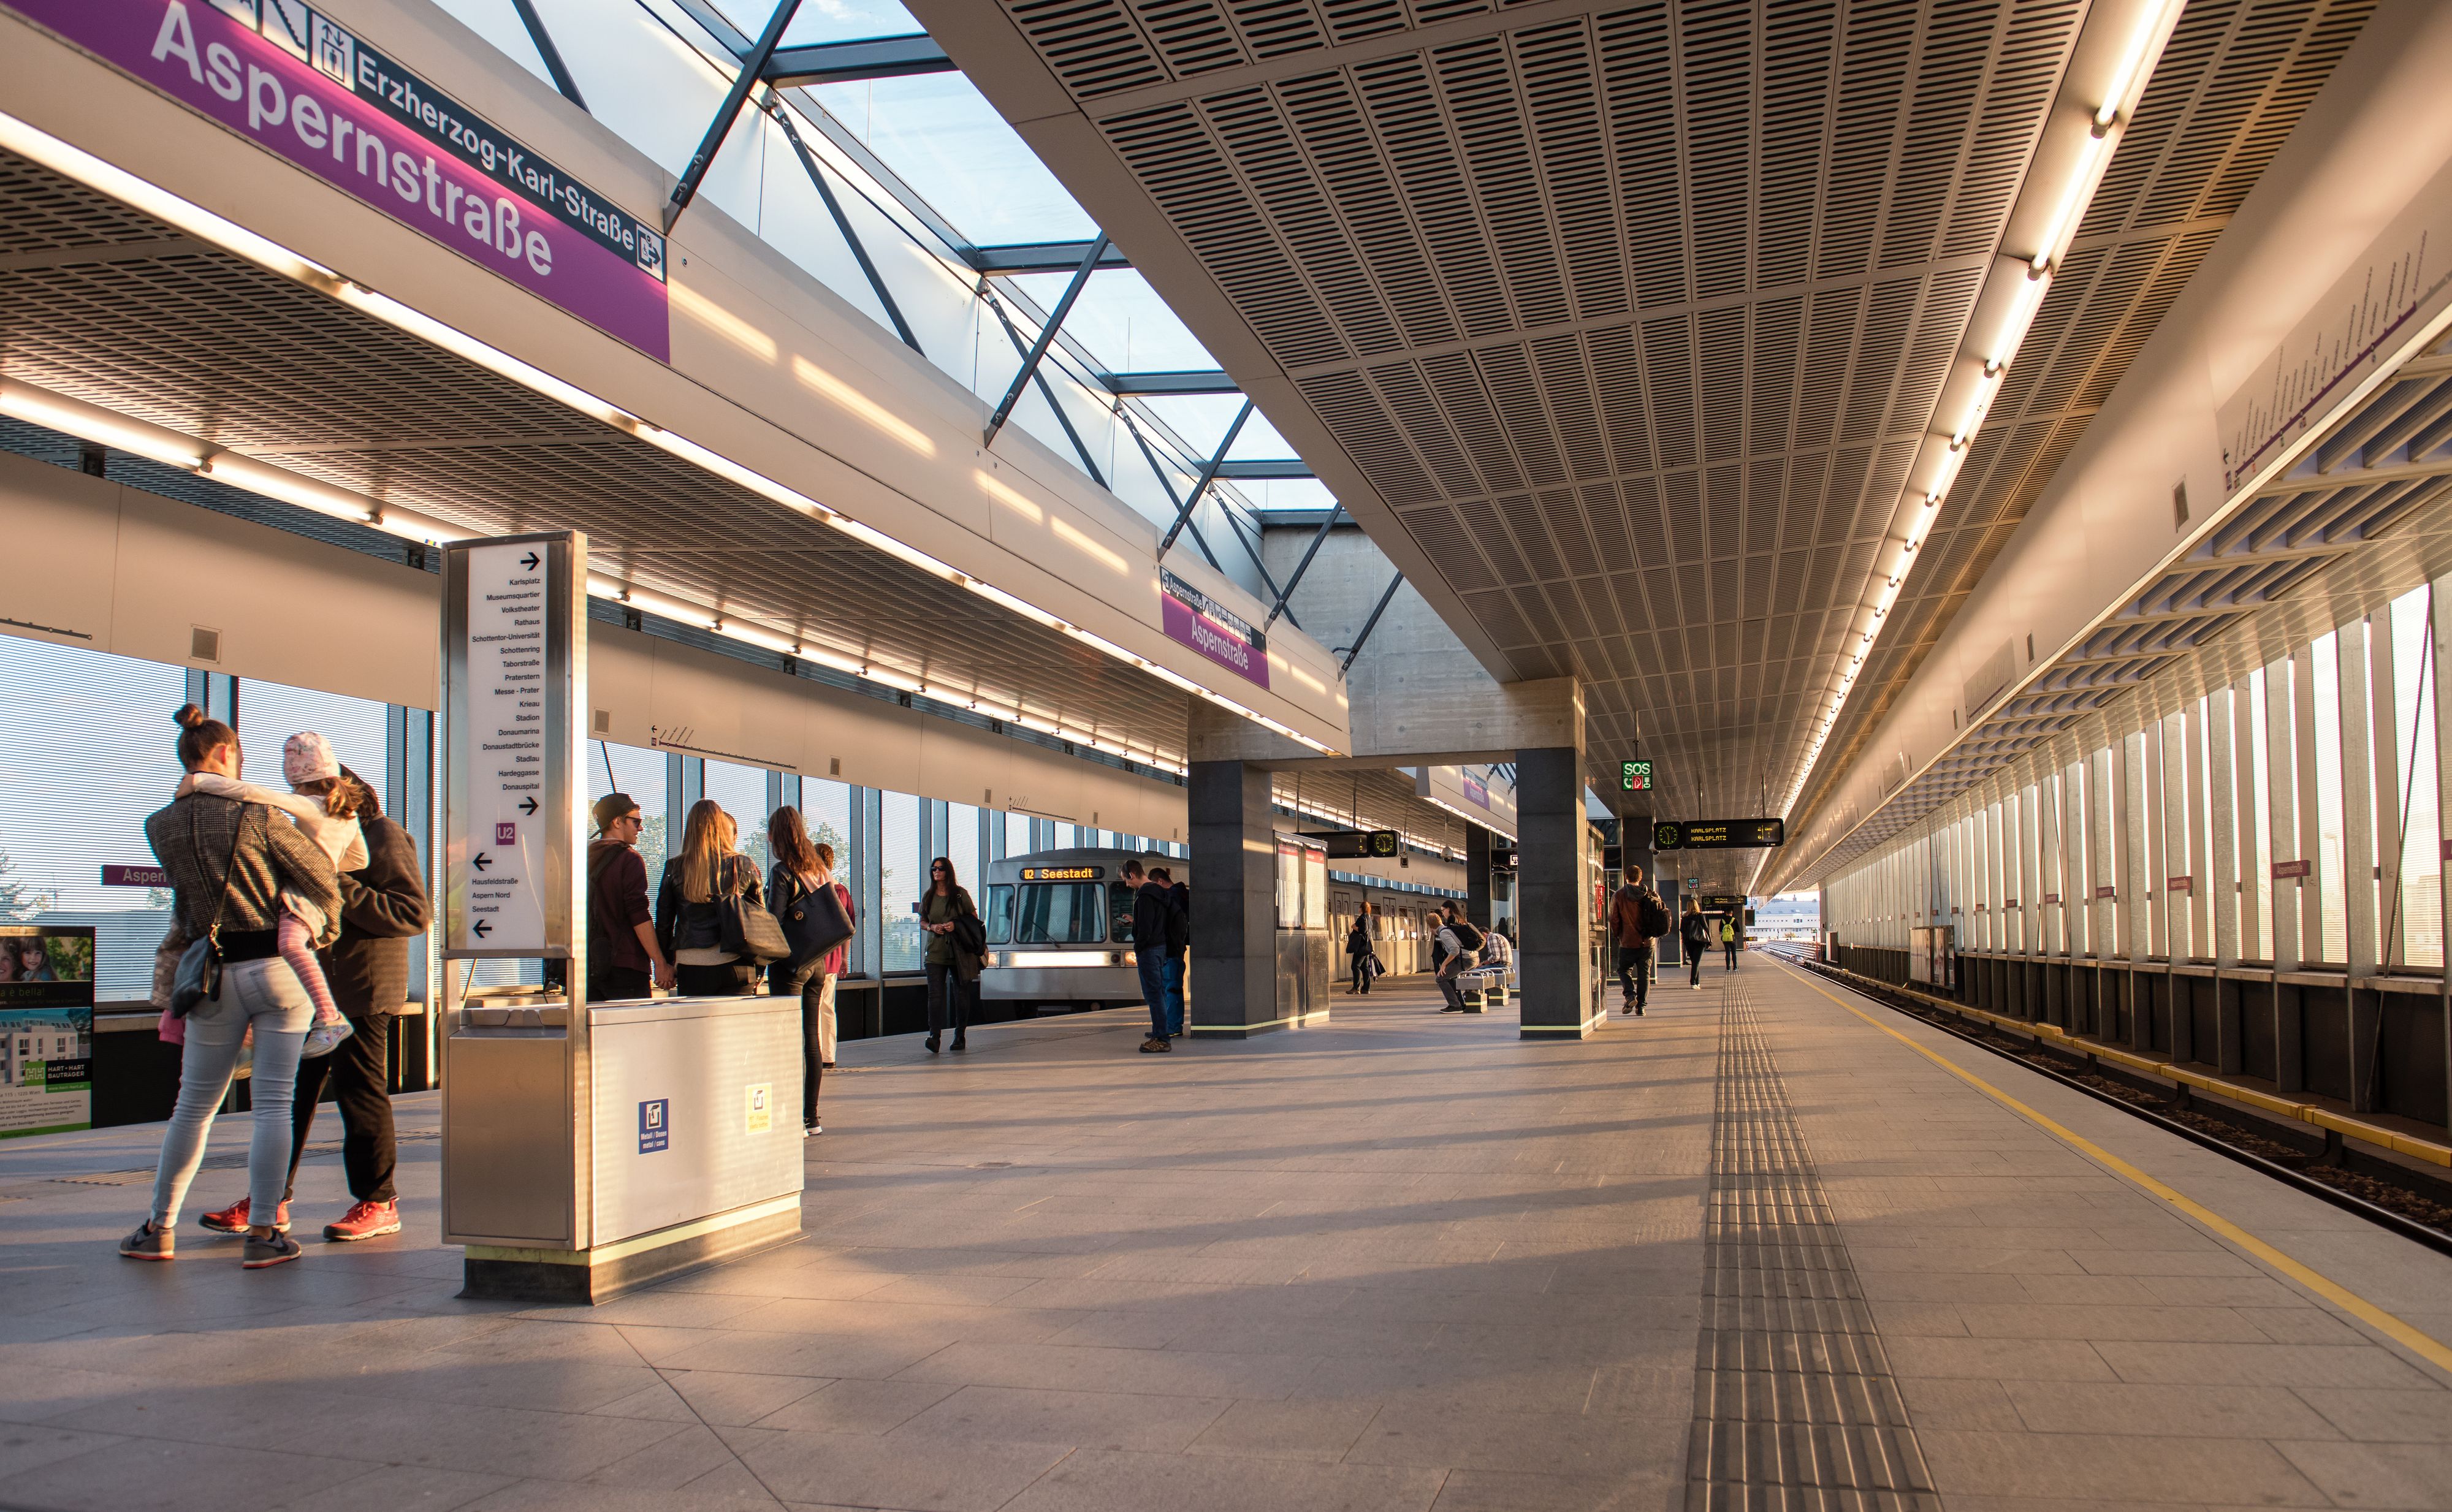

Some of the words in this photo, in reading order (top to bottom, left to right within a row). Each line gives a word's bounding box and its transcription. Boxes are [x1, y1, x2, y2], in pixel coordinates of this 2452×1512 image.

[151, 0, 552, 276] Aspernstraße
[358, 51, 634, 250] Erzherzog-Karl-Straße
[486, 591, 541, 601] Museumsquartier
[1170, 577, 1202, 609] Aspernstraße
[501, 605, 540, 614] Volkstheater
[472, 632, 540, 642] Schottentor-Universität
[1192, 616, 1248, 670] Aspernstraße
[500, 645, 540, 654] Schottenring
[483, 742, 539, 750] Donaustadtbrücke
[498, 769, 539, 778] Hardeggasse
[1624, 763, 1650, 775] SOS
[503, 783, 539, 791] Donauspital
[497, 827, 514, 840] U2
[1024, 869, 1034, 879] U2
[1041, 868, 1092, 879] Seestadt
[19, 987, 45, 996] bella!
